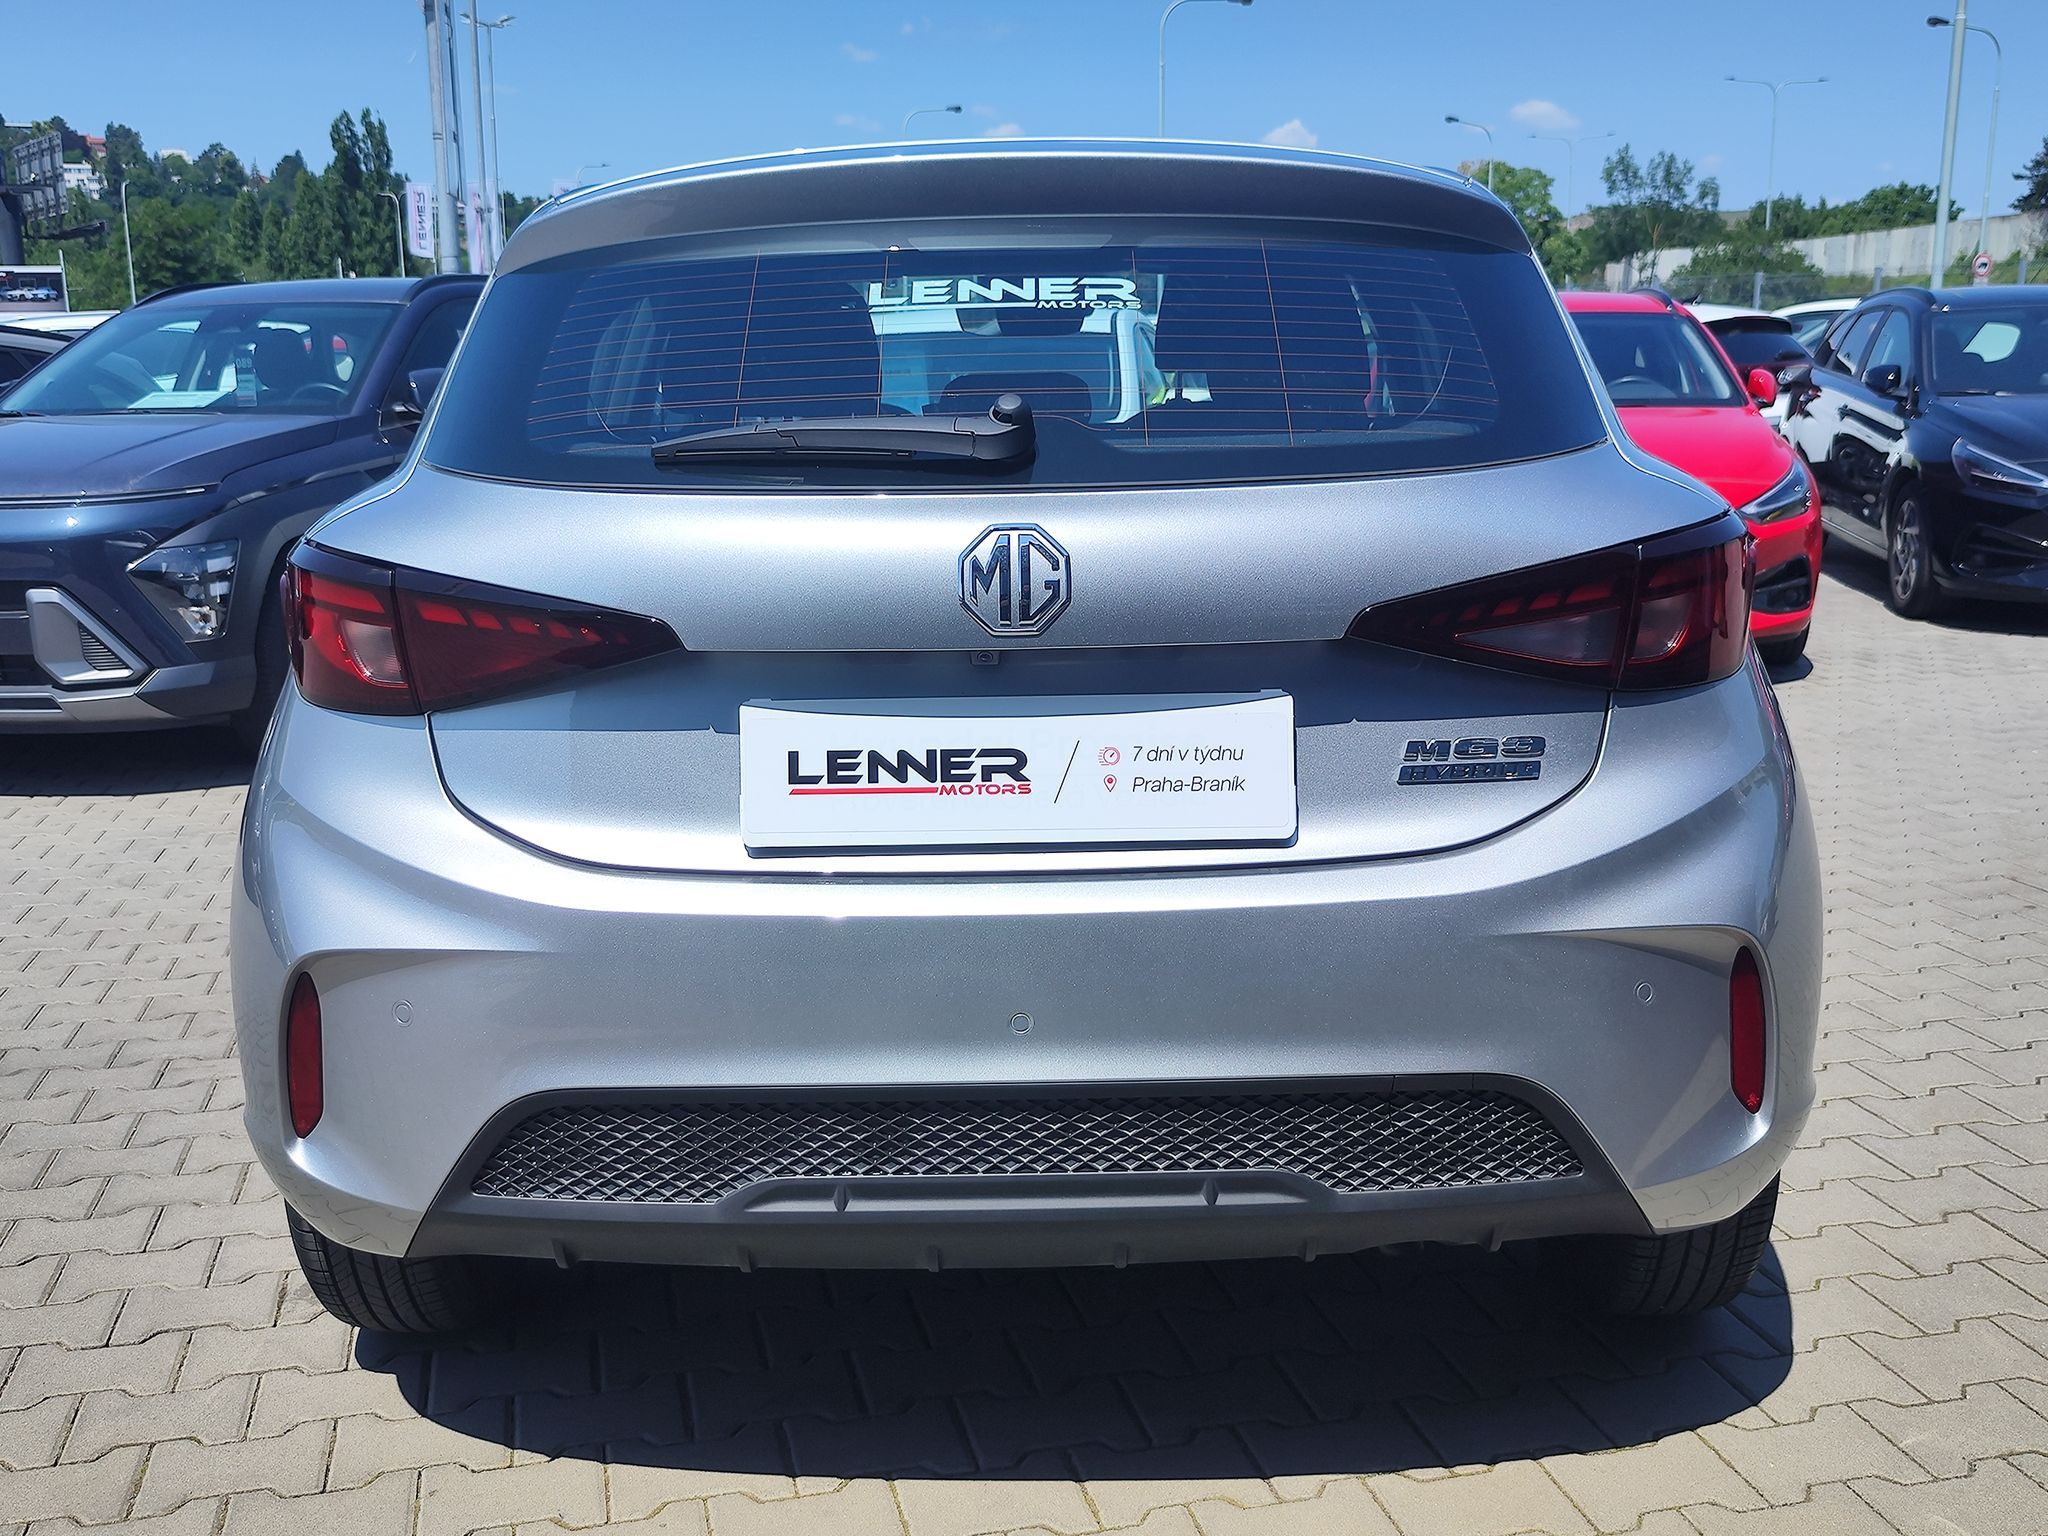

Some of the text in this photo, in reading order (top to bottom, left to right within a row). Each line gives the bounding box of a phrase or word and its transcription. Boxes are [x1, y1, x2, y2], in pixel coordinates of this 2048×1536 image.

[868, 277, 1140, 306] LENNER
[1035, 299, 1142, 310] MOTORS
[968, 533, 1061, 627] MG
[1133, 745, 1244, 765] 7 dní v týdnu
[1402, 735, 1546, 762] MG3
[787, 748, 1031, 785] LENNER
[938, 783, 1032, 796] MOTORS
[1132, 775, 1246, 793] Praha-Braník
